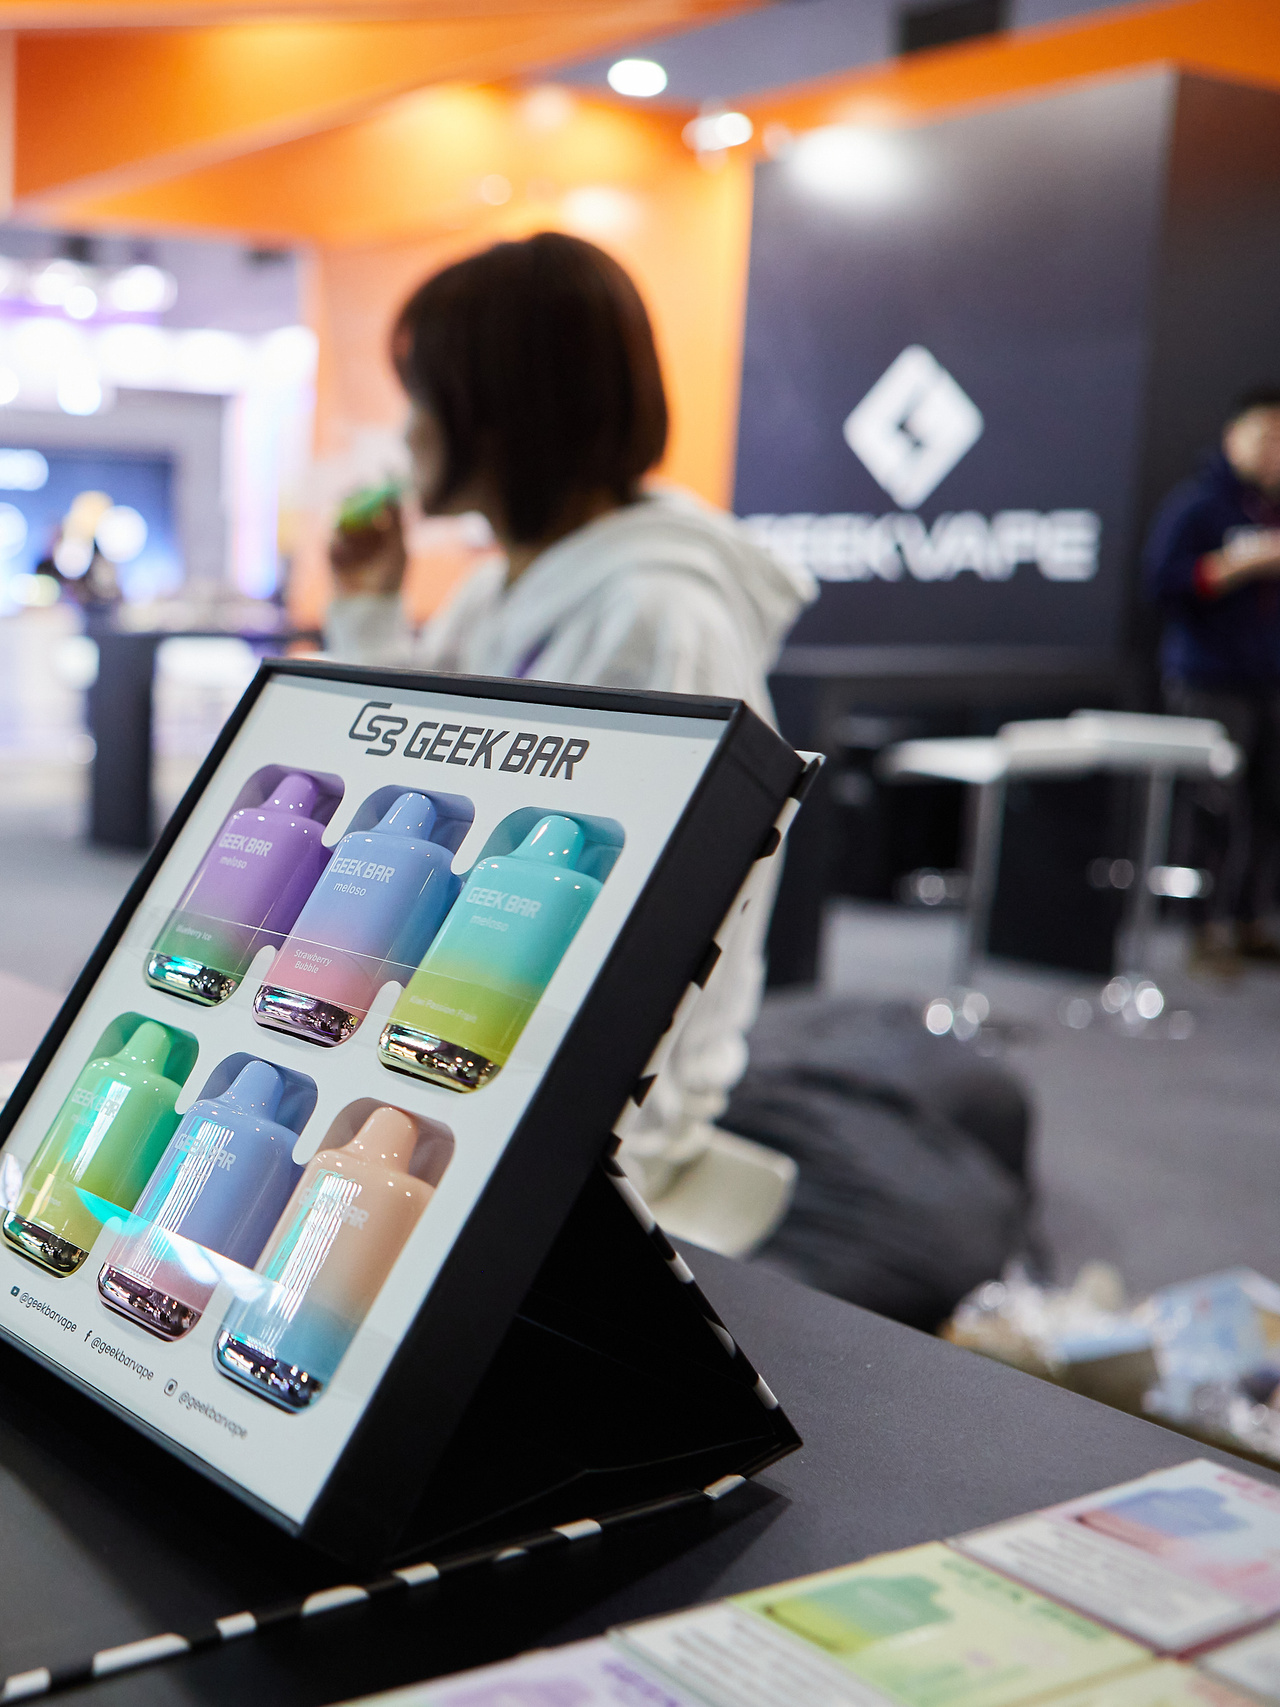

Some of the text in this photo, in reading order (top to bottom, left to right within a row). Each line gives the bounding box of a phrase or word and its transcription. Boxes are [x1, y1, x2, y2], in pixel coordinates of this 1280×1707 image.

[403, 721, 509, 769] GEEK
[499, 732, 590, 780] BAR
[219, 833, 273, 857] GEEK BAR
[220, 855, 247, 869] meloso
[331, 857, 396, 883] GEEK BAR
[333, 882, 367, 896] meloso
[466, 886, 542, 918] GEEK BAR
[470, 914, 510, 932] meloso
[294, 949, 333, 967] Strawberry
[294, 960, 320, 974] Bubble
[205, 1145, 237, 1171] BAR
[19, 1292, 78, 1333] @geekbarvape
[90, 1336, 154, 1381] @geekbarvape
[178, 1392, 248, 1439] @geekbarvape
